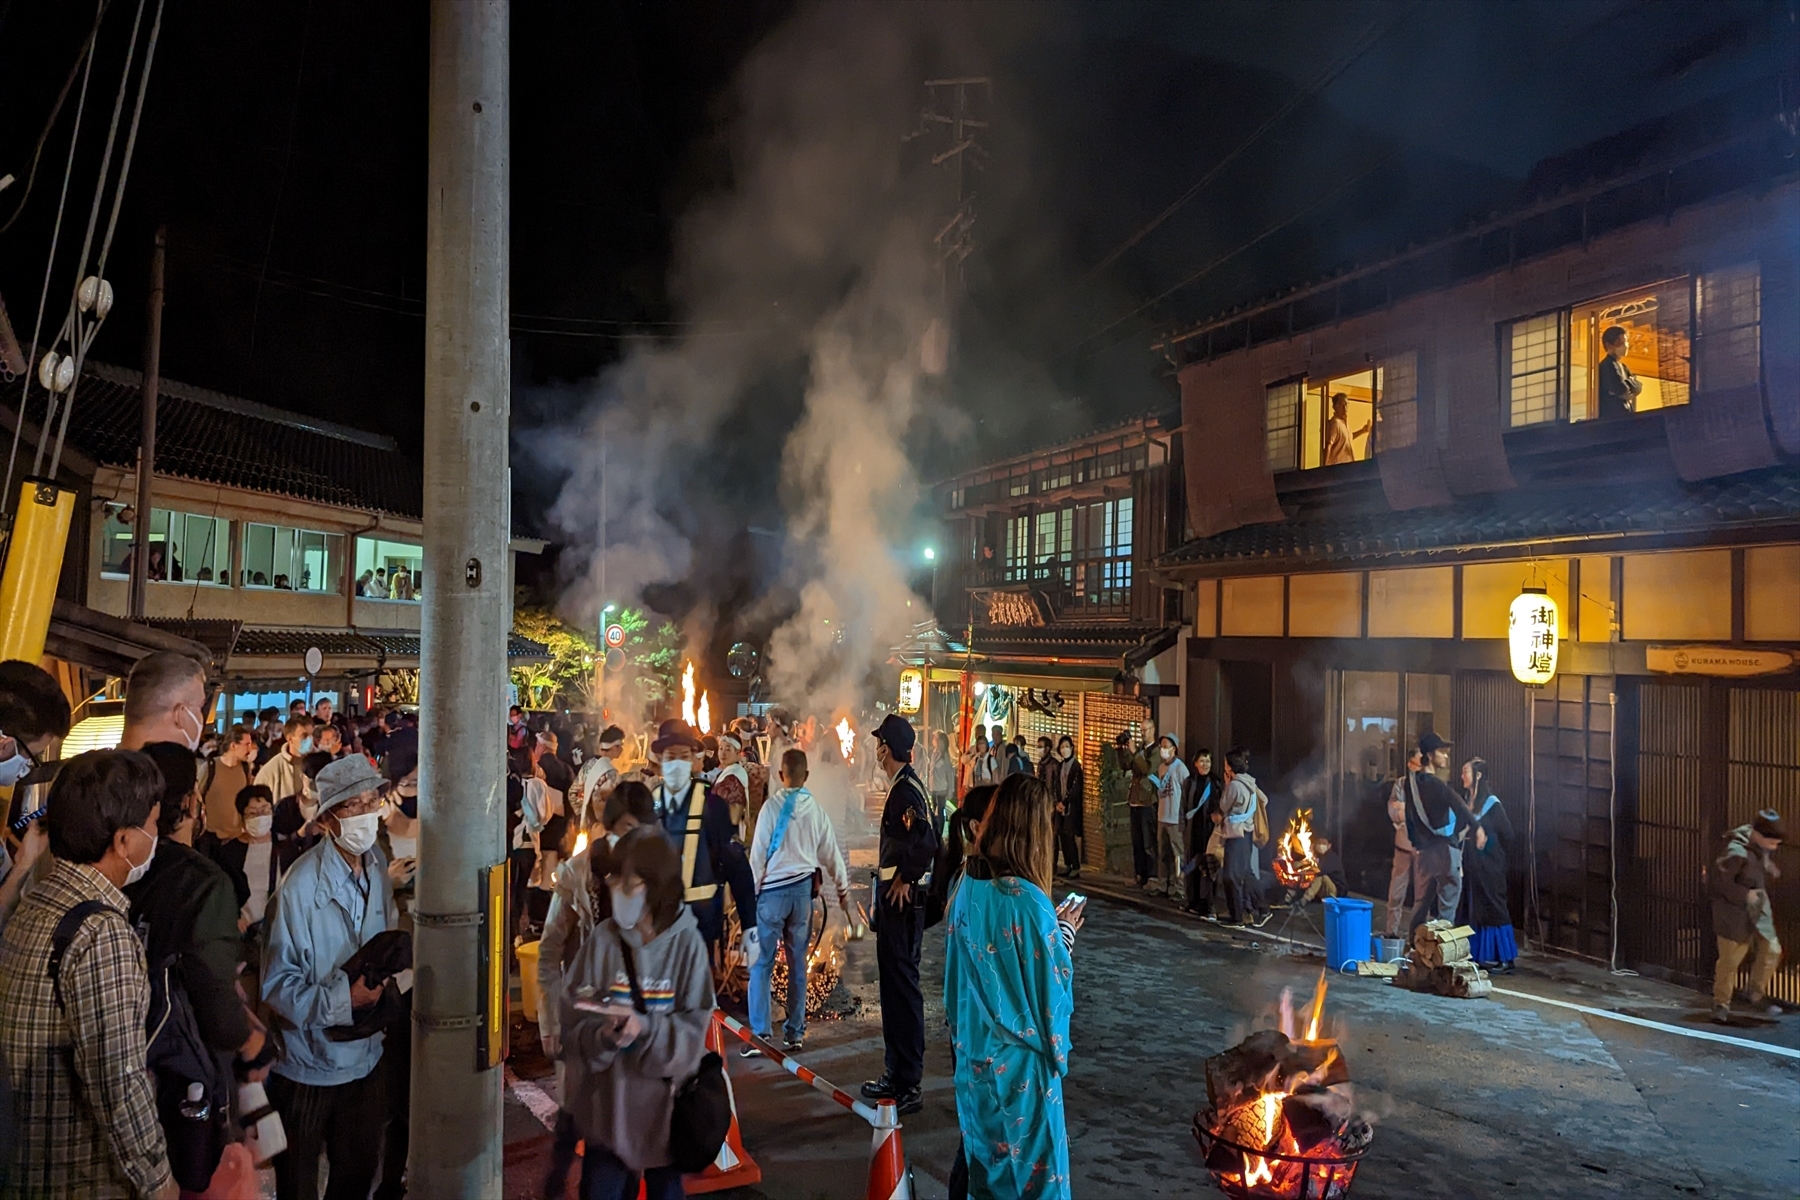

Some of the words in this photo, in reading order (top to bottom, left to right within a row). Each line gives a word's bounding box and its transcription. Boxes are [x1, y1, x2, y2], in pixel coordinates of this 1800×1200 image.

[610, 631, 621, 641] 40
[1528, 606, 1554, 673] 御神燈
